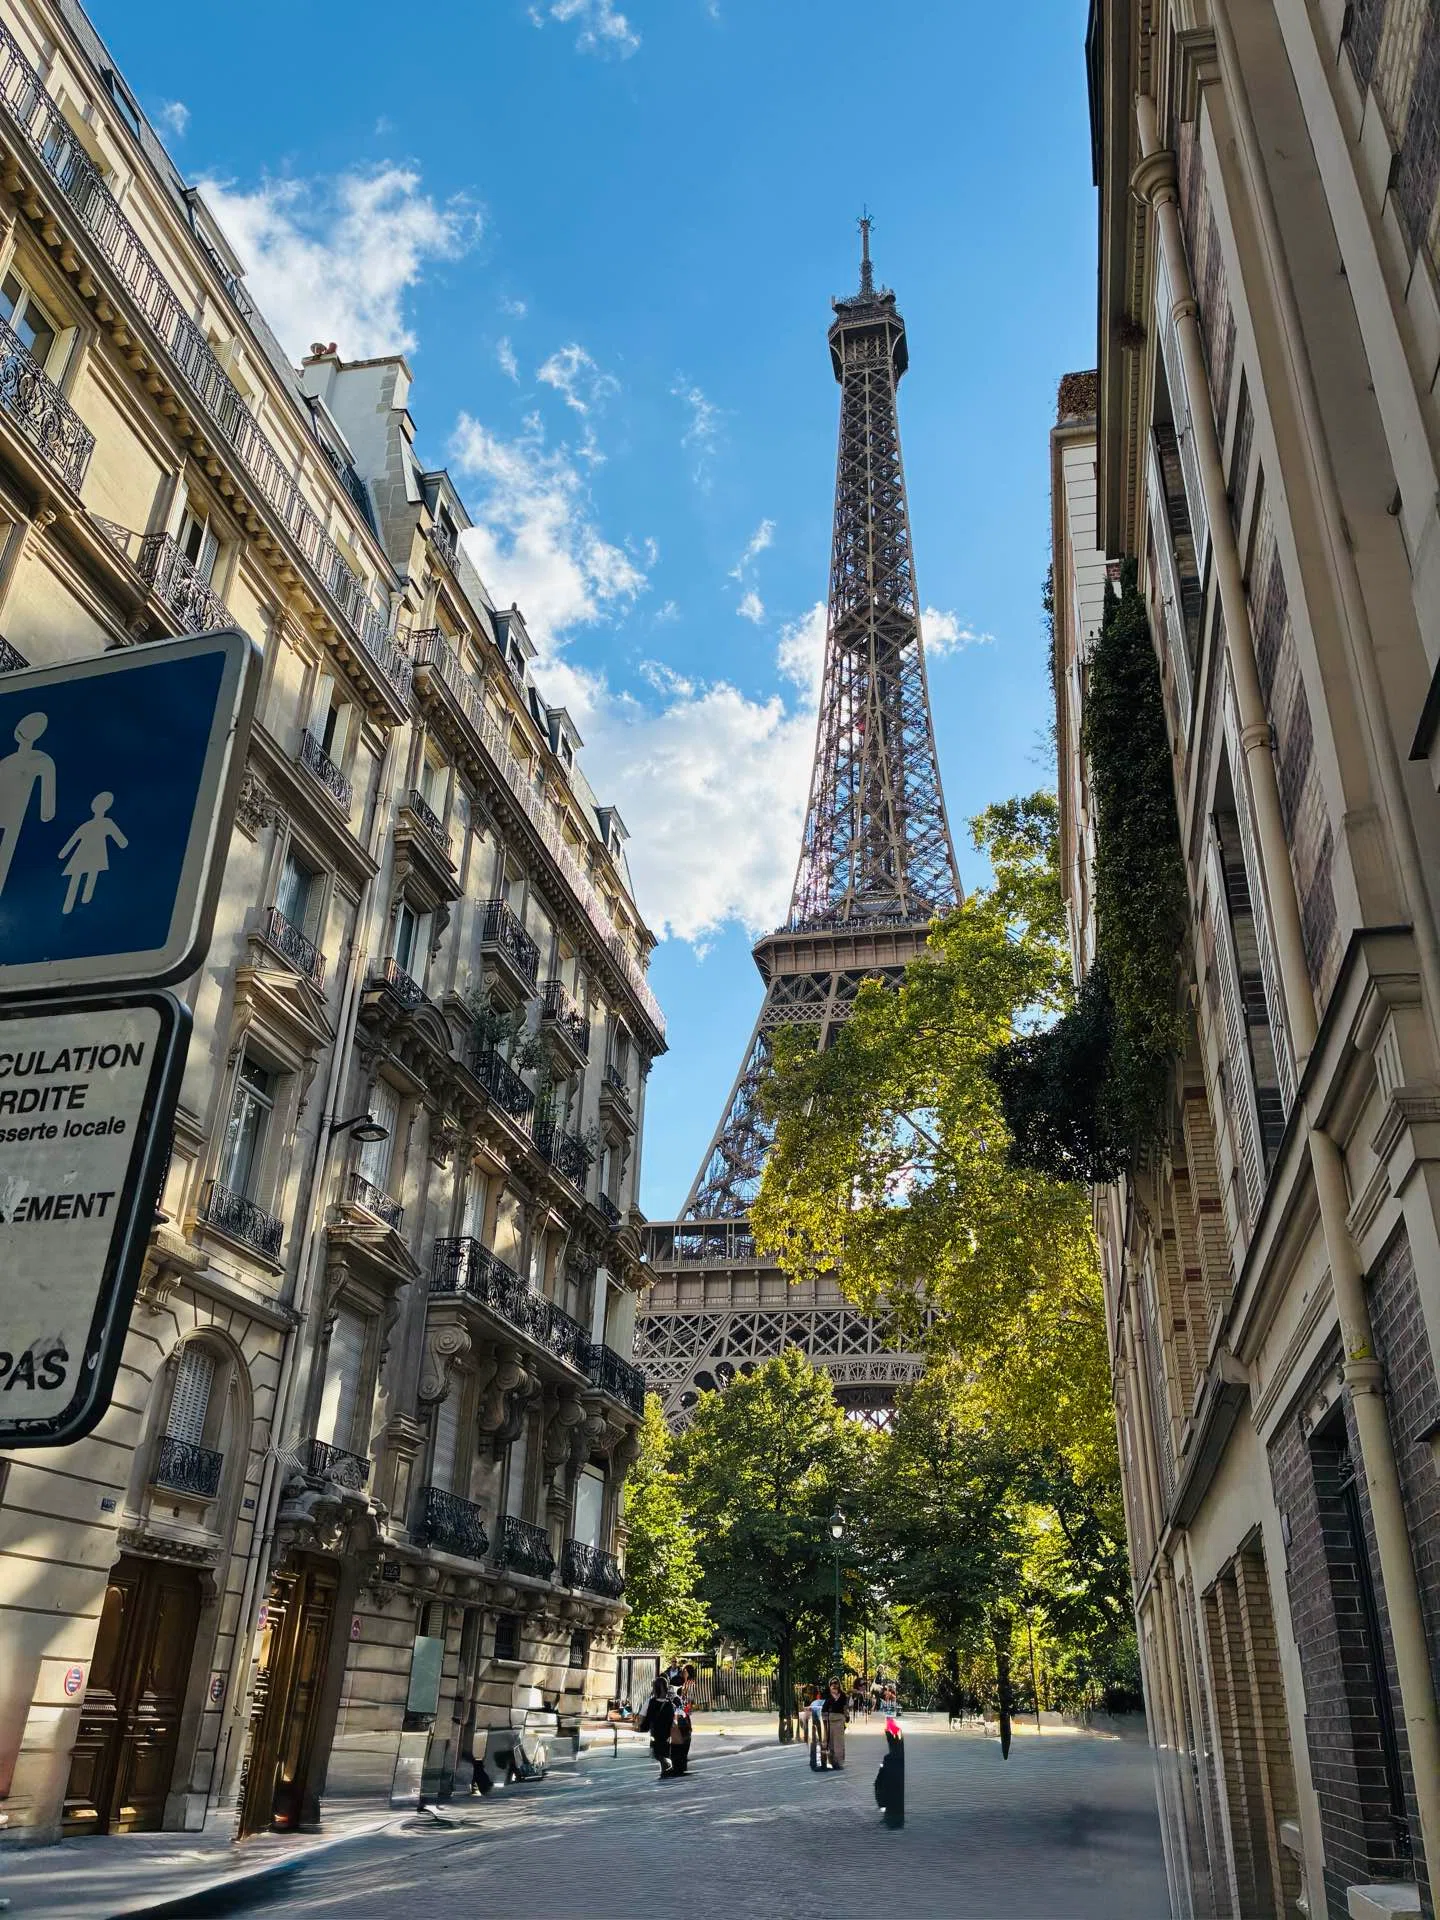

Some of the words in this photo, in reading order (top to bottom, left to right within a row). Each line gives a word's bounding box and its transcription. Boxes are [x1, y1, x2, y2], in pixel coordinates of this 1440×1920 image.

[0, 1042, 145, 1078] CULATION
[0, 1084, 89, 1115] RDITE
[63, 1116, 126, 1138] locale
[0, 1192, 115, 1223] EMENT
